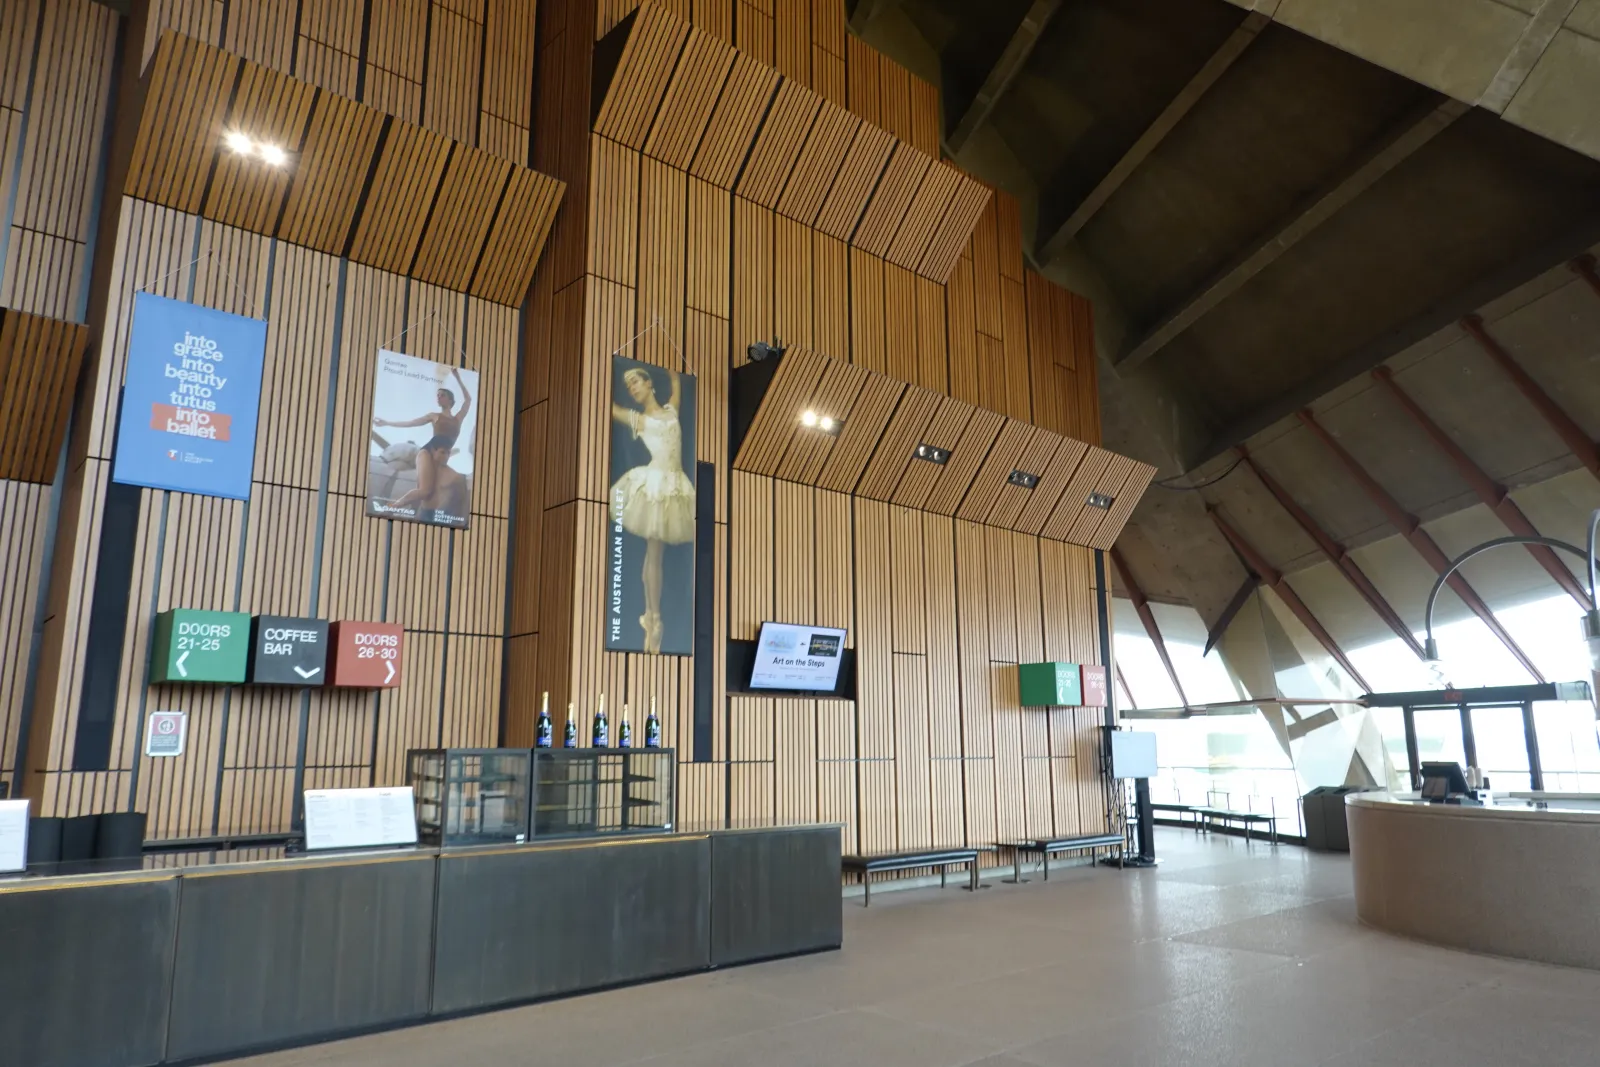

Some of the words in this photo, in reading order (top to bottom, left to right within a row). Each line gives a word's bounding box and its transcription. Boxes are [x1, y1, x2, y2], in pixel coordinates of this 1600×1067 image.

[185, 331, 217, 350] into
[174, 342, 223, 361] grace
[182, 355, 214, 373] into
[165, 363, 227, 390] beauty
[179, 379, 211, 398] into
[170, 391, 216, 411] tutus
[176, 406, 209, 424] into
[166, 418, 216, 439] ballet
[382, 505, 415, 515] QANTAS
[615, 488, 624, 533] BALLET
[612, 536, 623, 614] AUSTRALIAN
[178, 622, 231, 638] DOORS
[264, 627, 318, 643] COFFEE
[612, 617, 621, 642] THE
[177, 637, 221, 651] 21-25
[355, 633, 398, 646] DOORS
[263, 643, 293, 656] BAR
[358, 646, 397, 660] 26-30
[772, 656, 784, 664] Art
[807, 659, 825, 668] Steps
